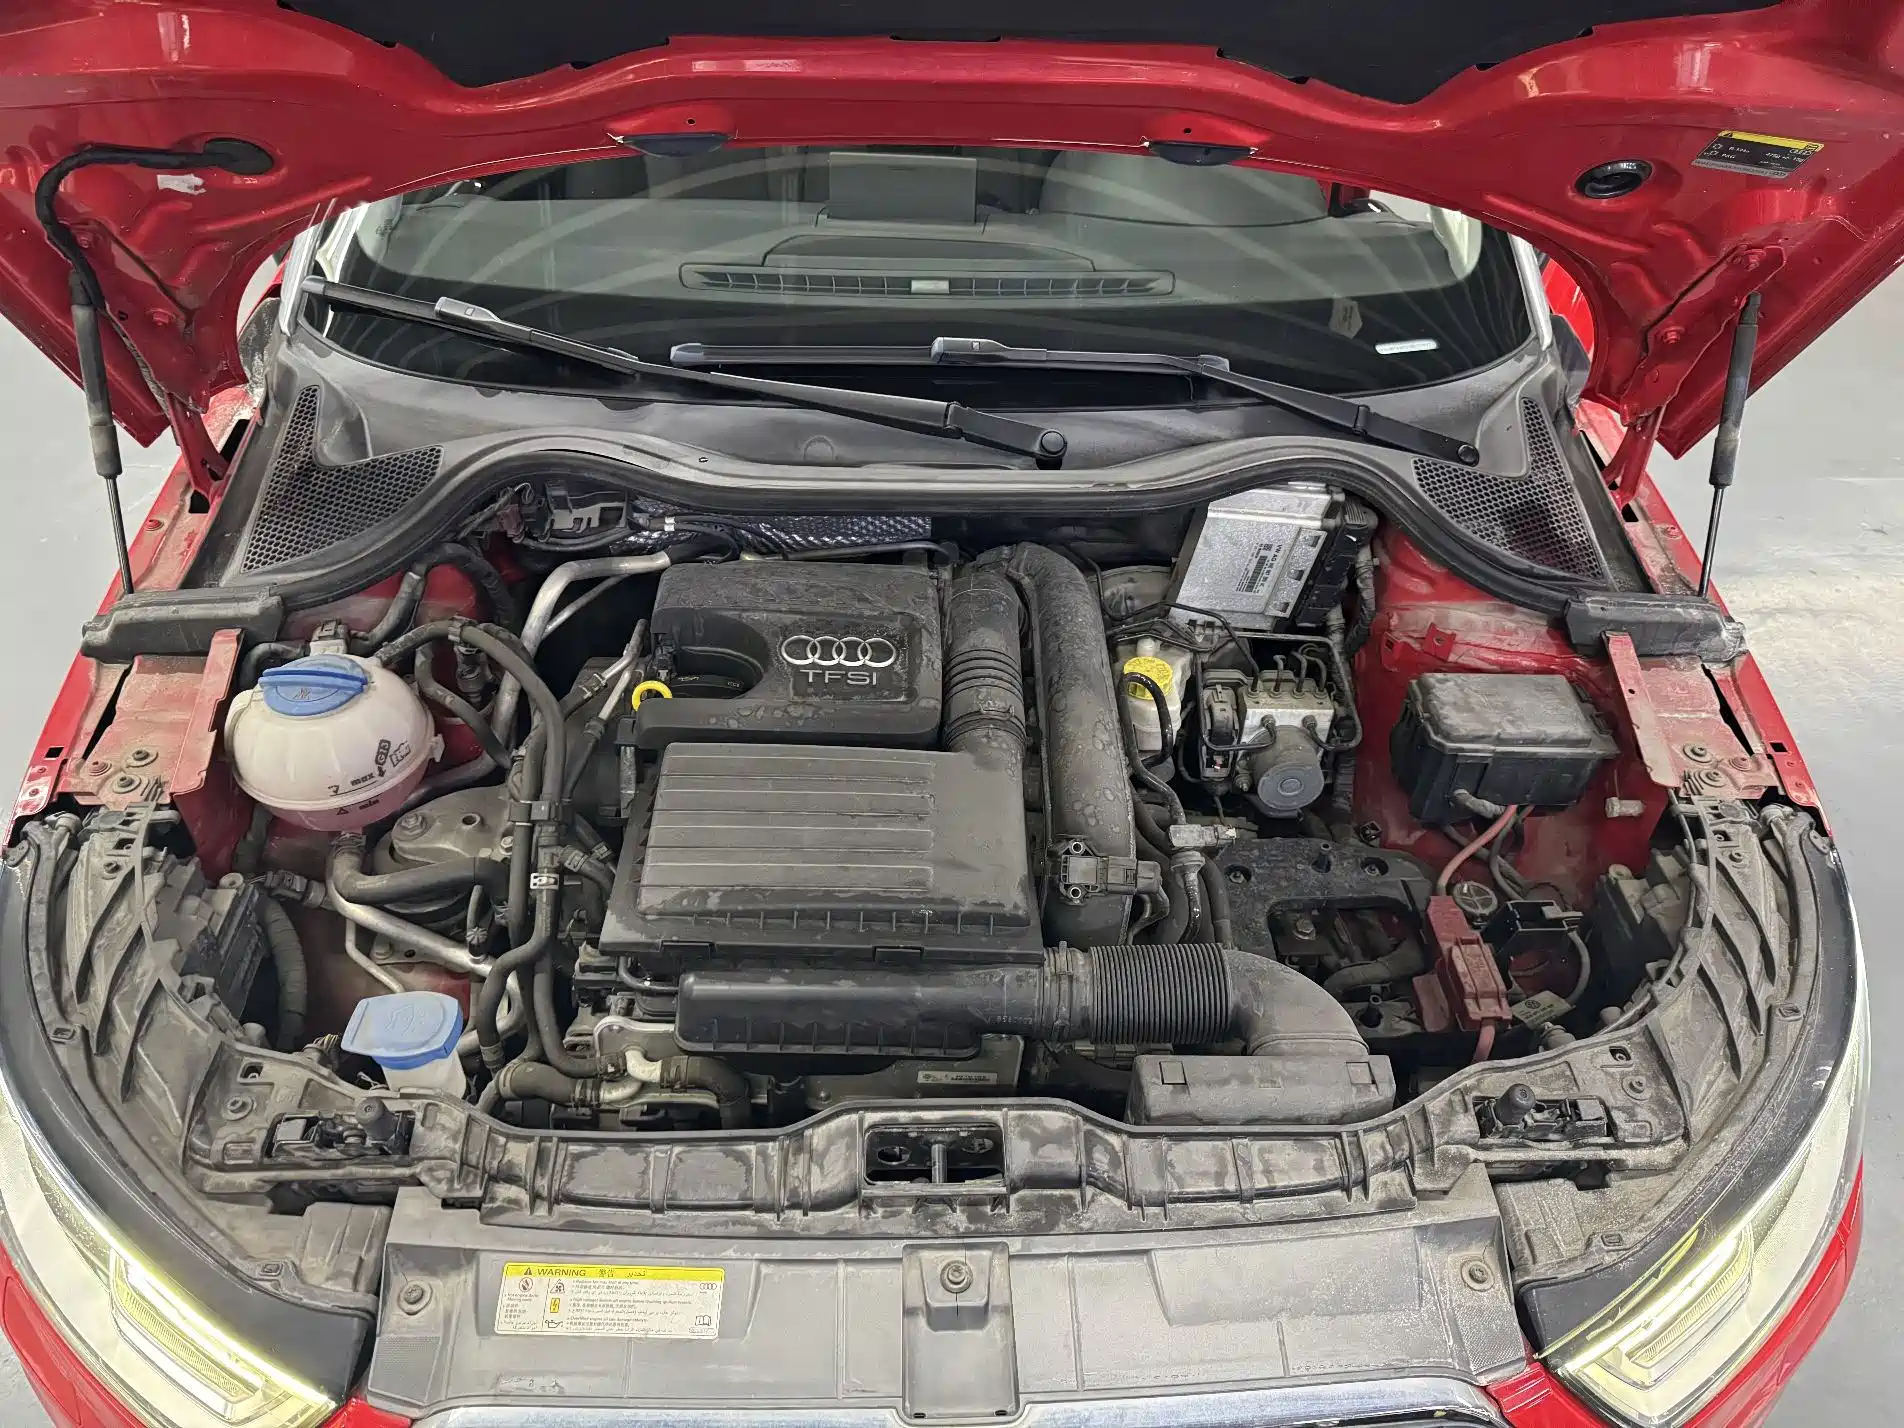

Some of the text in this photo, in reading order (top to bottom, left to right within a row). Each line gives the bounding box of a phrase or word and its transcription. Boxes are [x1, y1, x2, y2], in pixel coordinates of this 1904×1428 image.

[799, 669, 877, 686] TFSI
[351, 772, 375, 785] max
[359, 799, 380, 810] min
[537, 1268, 586, 1277] WARNING
